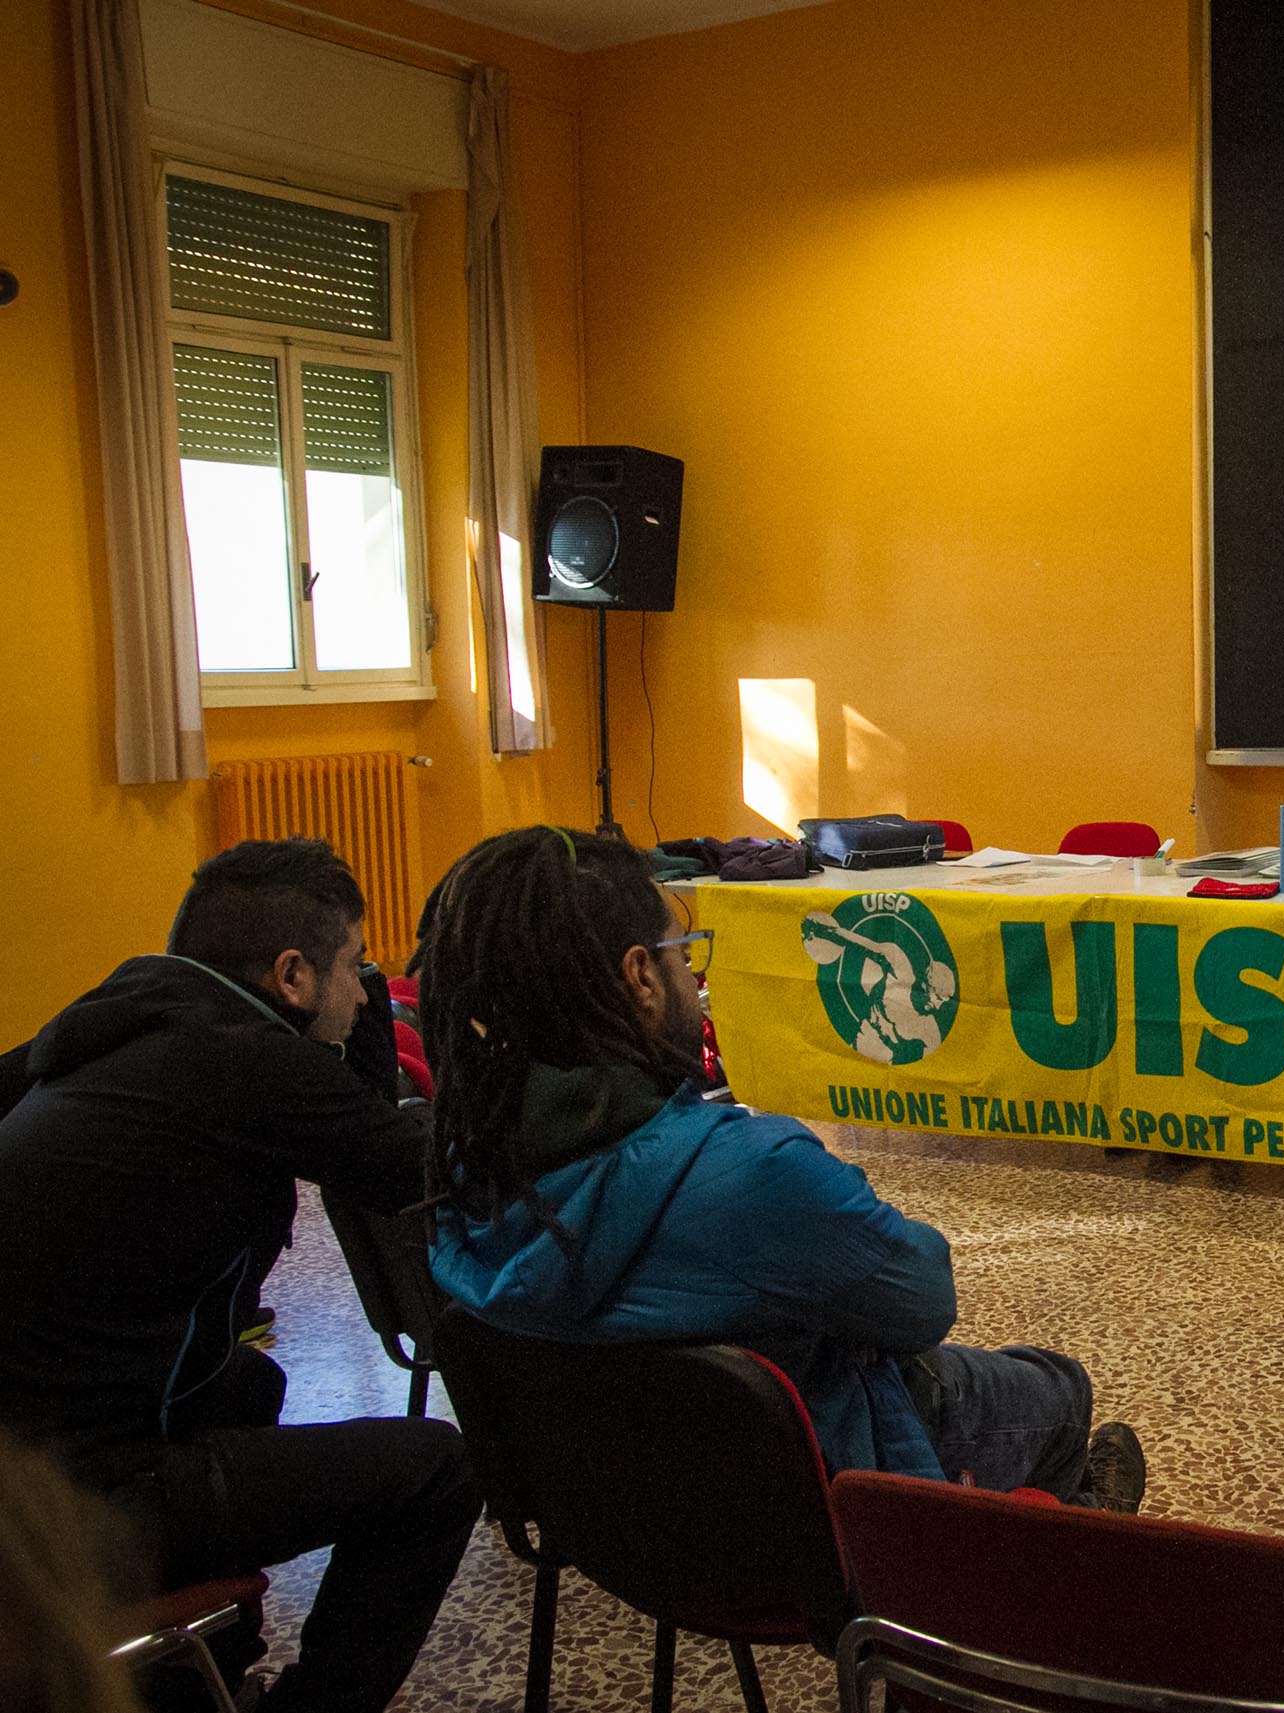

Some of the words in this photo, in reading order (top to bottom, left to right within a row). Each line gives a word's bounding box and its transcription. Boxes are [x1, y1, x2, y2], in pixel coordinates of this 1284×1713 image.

[861, 892, 911, 914] UISP
[828, 1085, 948, 1128] UNIONE
[960, 1094, 1110, 1141] ITALIANA
[1120, 1106, 1229, 1152] SPORT
